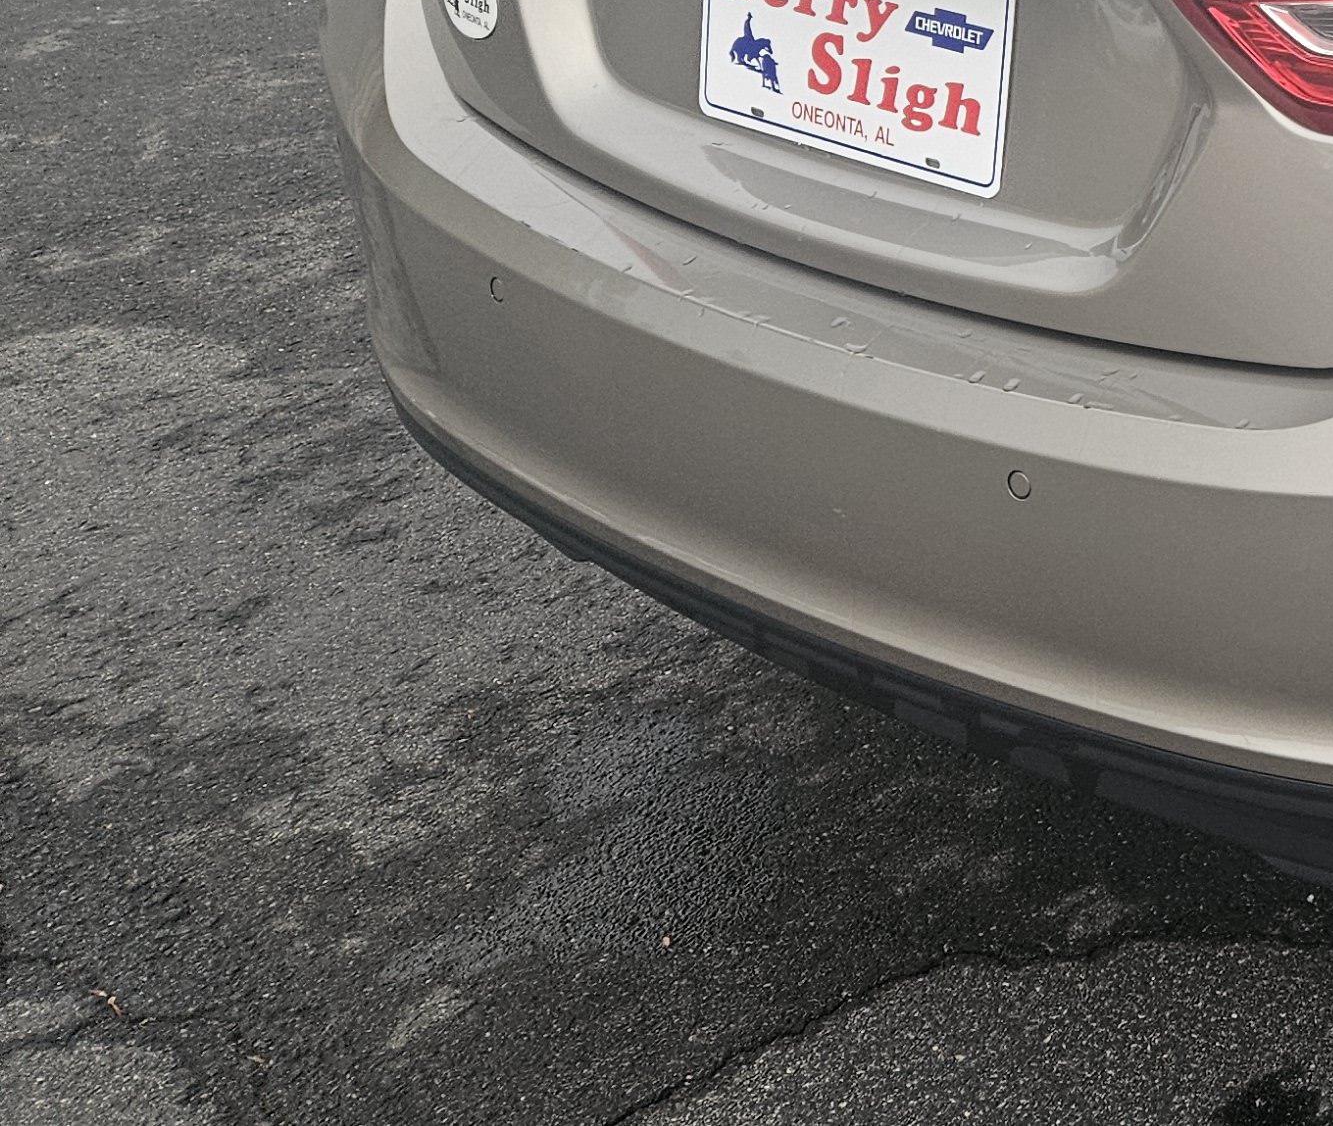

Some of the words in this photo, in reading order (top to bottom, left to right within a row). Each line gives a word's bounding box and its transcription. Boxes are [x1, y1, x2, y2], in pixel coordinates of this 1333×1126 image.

[914, 15, 985, 46] CHEVROLET
[806, 31, 982, 137] Sligh
[791, 101, 868, 141] ONEONTA,
[874, 124, 895, 147] AL
